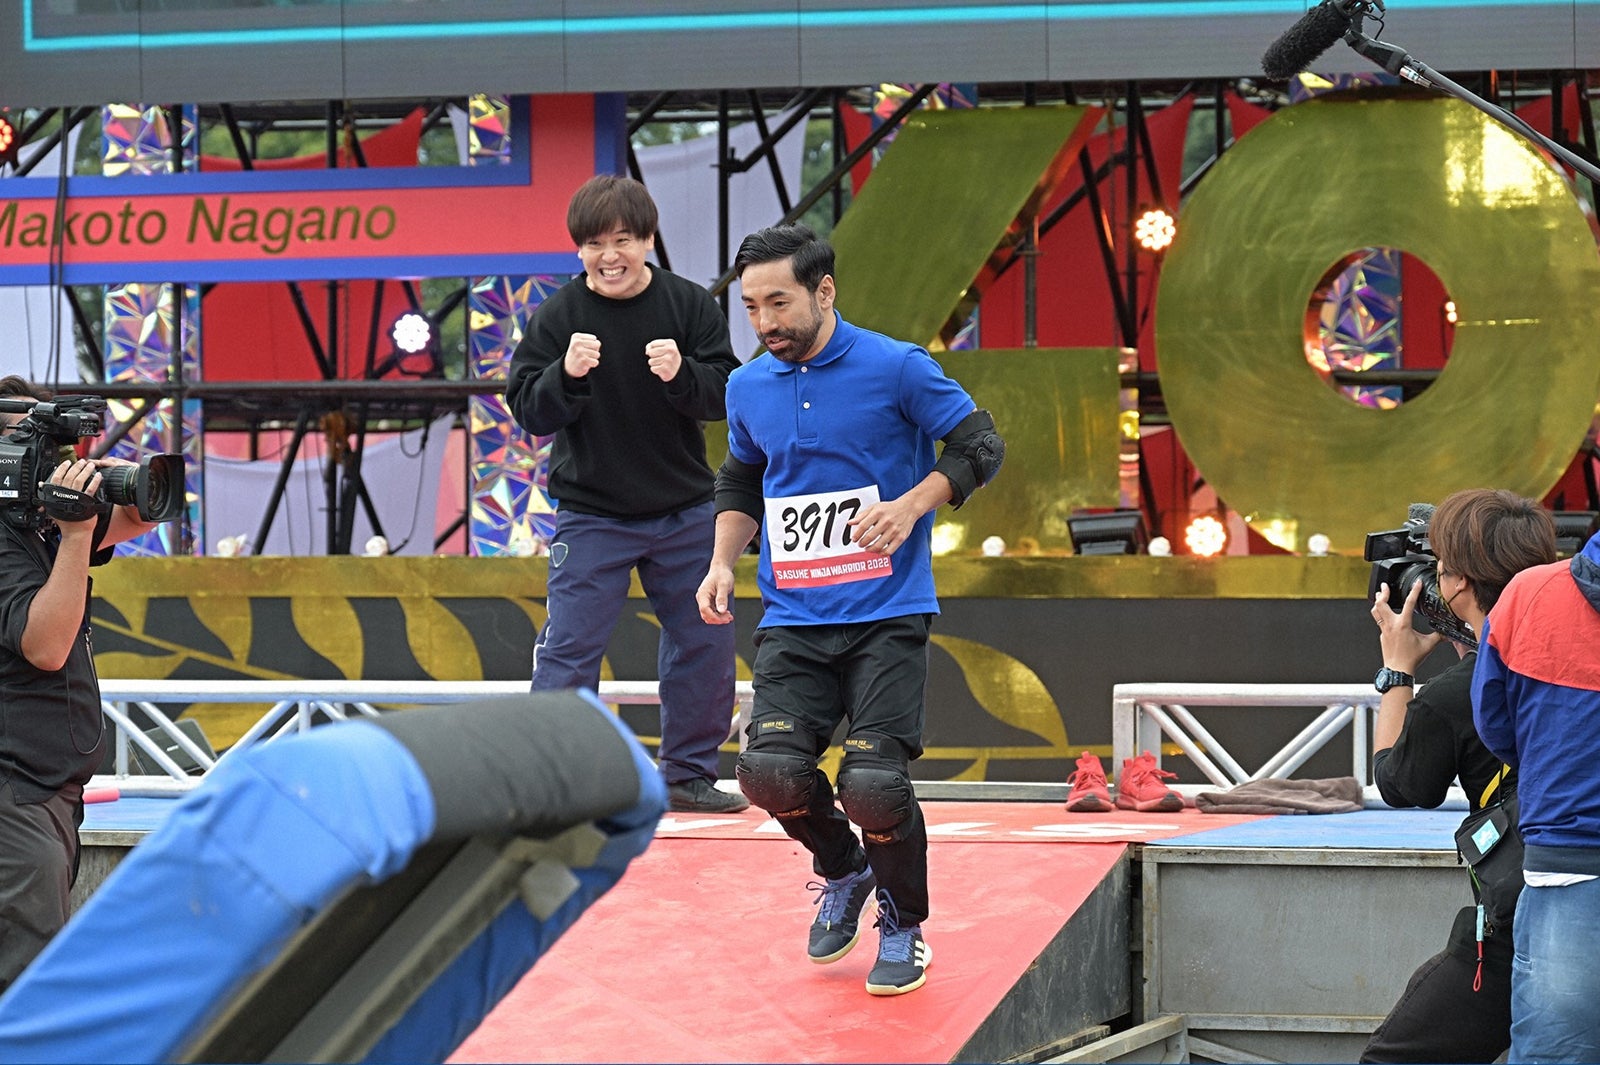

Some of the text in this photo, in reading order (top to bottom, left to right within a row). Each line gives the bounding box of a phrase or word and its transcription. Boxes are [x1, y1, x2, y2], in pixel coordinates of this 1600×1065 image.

[186, 197, 397, 255] Nagano
[4, 476, 10, 487] 4
[52, 491, 79, 500] FUJINON
[782, 498, 861, 552] 3917
[776, 557, 890, 580] SASUKE NINJA WARRIOR 2022
